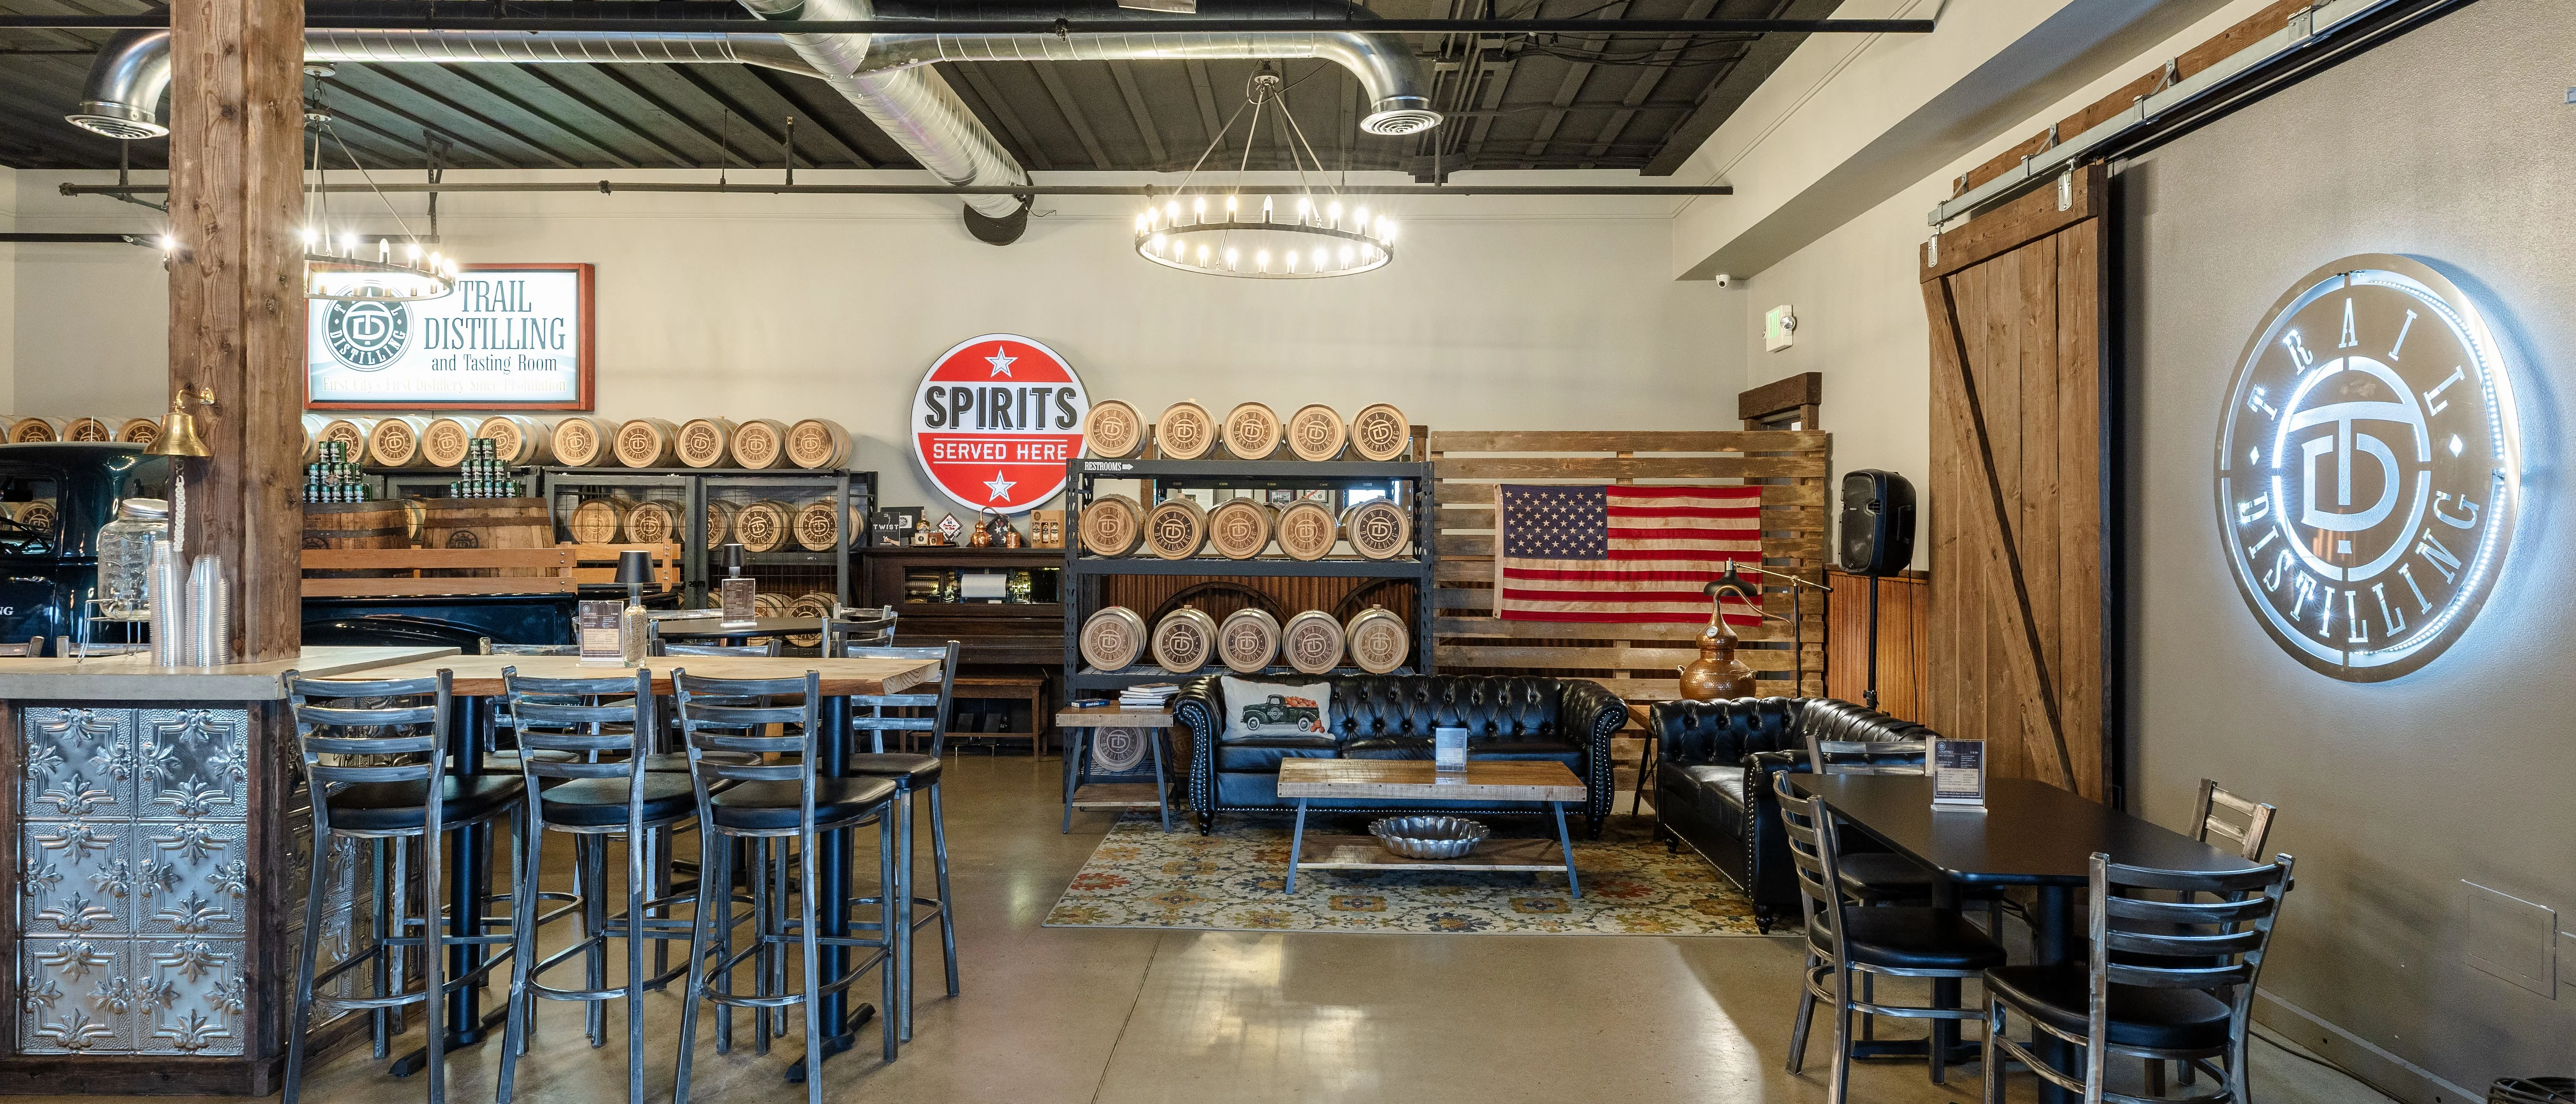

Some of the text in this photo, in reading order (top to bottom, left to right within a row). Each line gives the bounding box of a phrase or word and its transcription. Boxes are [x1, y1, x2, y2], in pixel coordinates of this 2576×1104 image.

[334, 287, 403, 316] TAL
[459, 281, 532, 312] TRAIL
[1768, 310, 1779, 338] EXIT
[424, 318, 565, 350] DISTILLING
[330, 330, 406, 365] DISTILLING
[432, 354, 556, 374] and Tasting Room
[2248, 298, 2465, 421] TRAIL
[324, 377, 348, 391] First
[925, 386, 1077, 430] SPIRITS
[1097, 411, 1129, 425] TRAIL
[1170, 413, 1200, 426] TRAIL
[1238, 413, 1268, 428] TRAIL
[1302, 415, 1333, 430] TRAIL
[1362, 414, 1394, 429] TRAIL
[626, 429, 651, 438] TRAIL
[688, 428, 715, 441] TRAIL
[743, 429, 770, 441] TRAIL
[1094, 429, 1129, 447] DISTILLING
[1167, 432, 1202, 449] DISTILLING
[1234, 431, 1268, 449] DISTILLING
[1364, 431, 1399, 451] DISTILLING
[1298, 433, 1333, 451] DISTILLING
[624, 446, 652, 458] DISTILLING
[685, 443, 714, 459] DISTILLING
[741, 447, 771, 459] DISTILLING
[933, 443, 1067, 460] SERVED HERE
[1084, 462, 1121, 471] RESTROOMS
[1157, 512, 1190, 527] TRAIL
[1223, 512, 1255, 524] TRAIL
[1363, 511, 1397, 526] TRAIL
[1154, 532, 1191, 550] DISTILLING
[1222, 532, 1257, 548] DISTILLING
[1361, 531, 1397, 548] DISTILLING
[2238, 490, 2479, 643] DISTILLING
[1166, 625, 1199, 639] TRAIL
[1231, 625, 1263, 639] TRAIL
[1163, 645, 1199, 663] DISTILLING
[1230, 645, 1264, 661] DISTILLING
